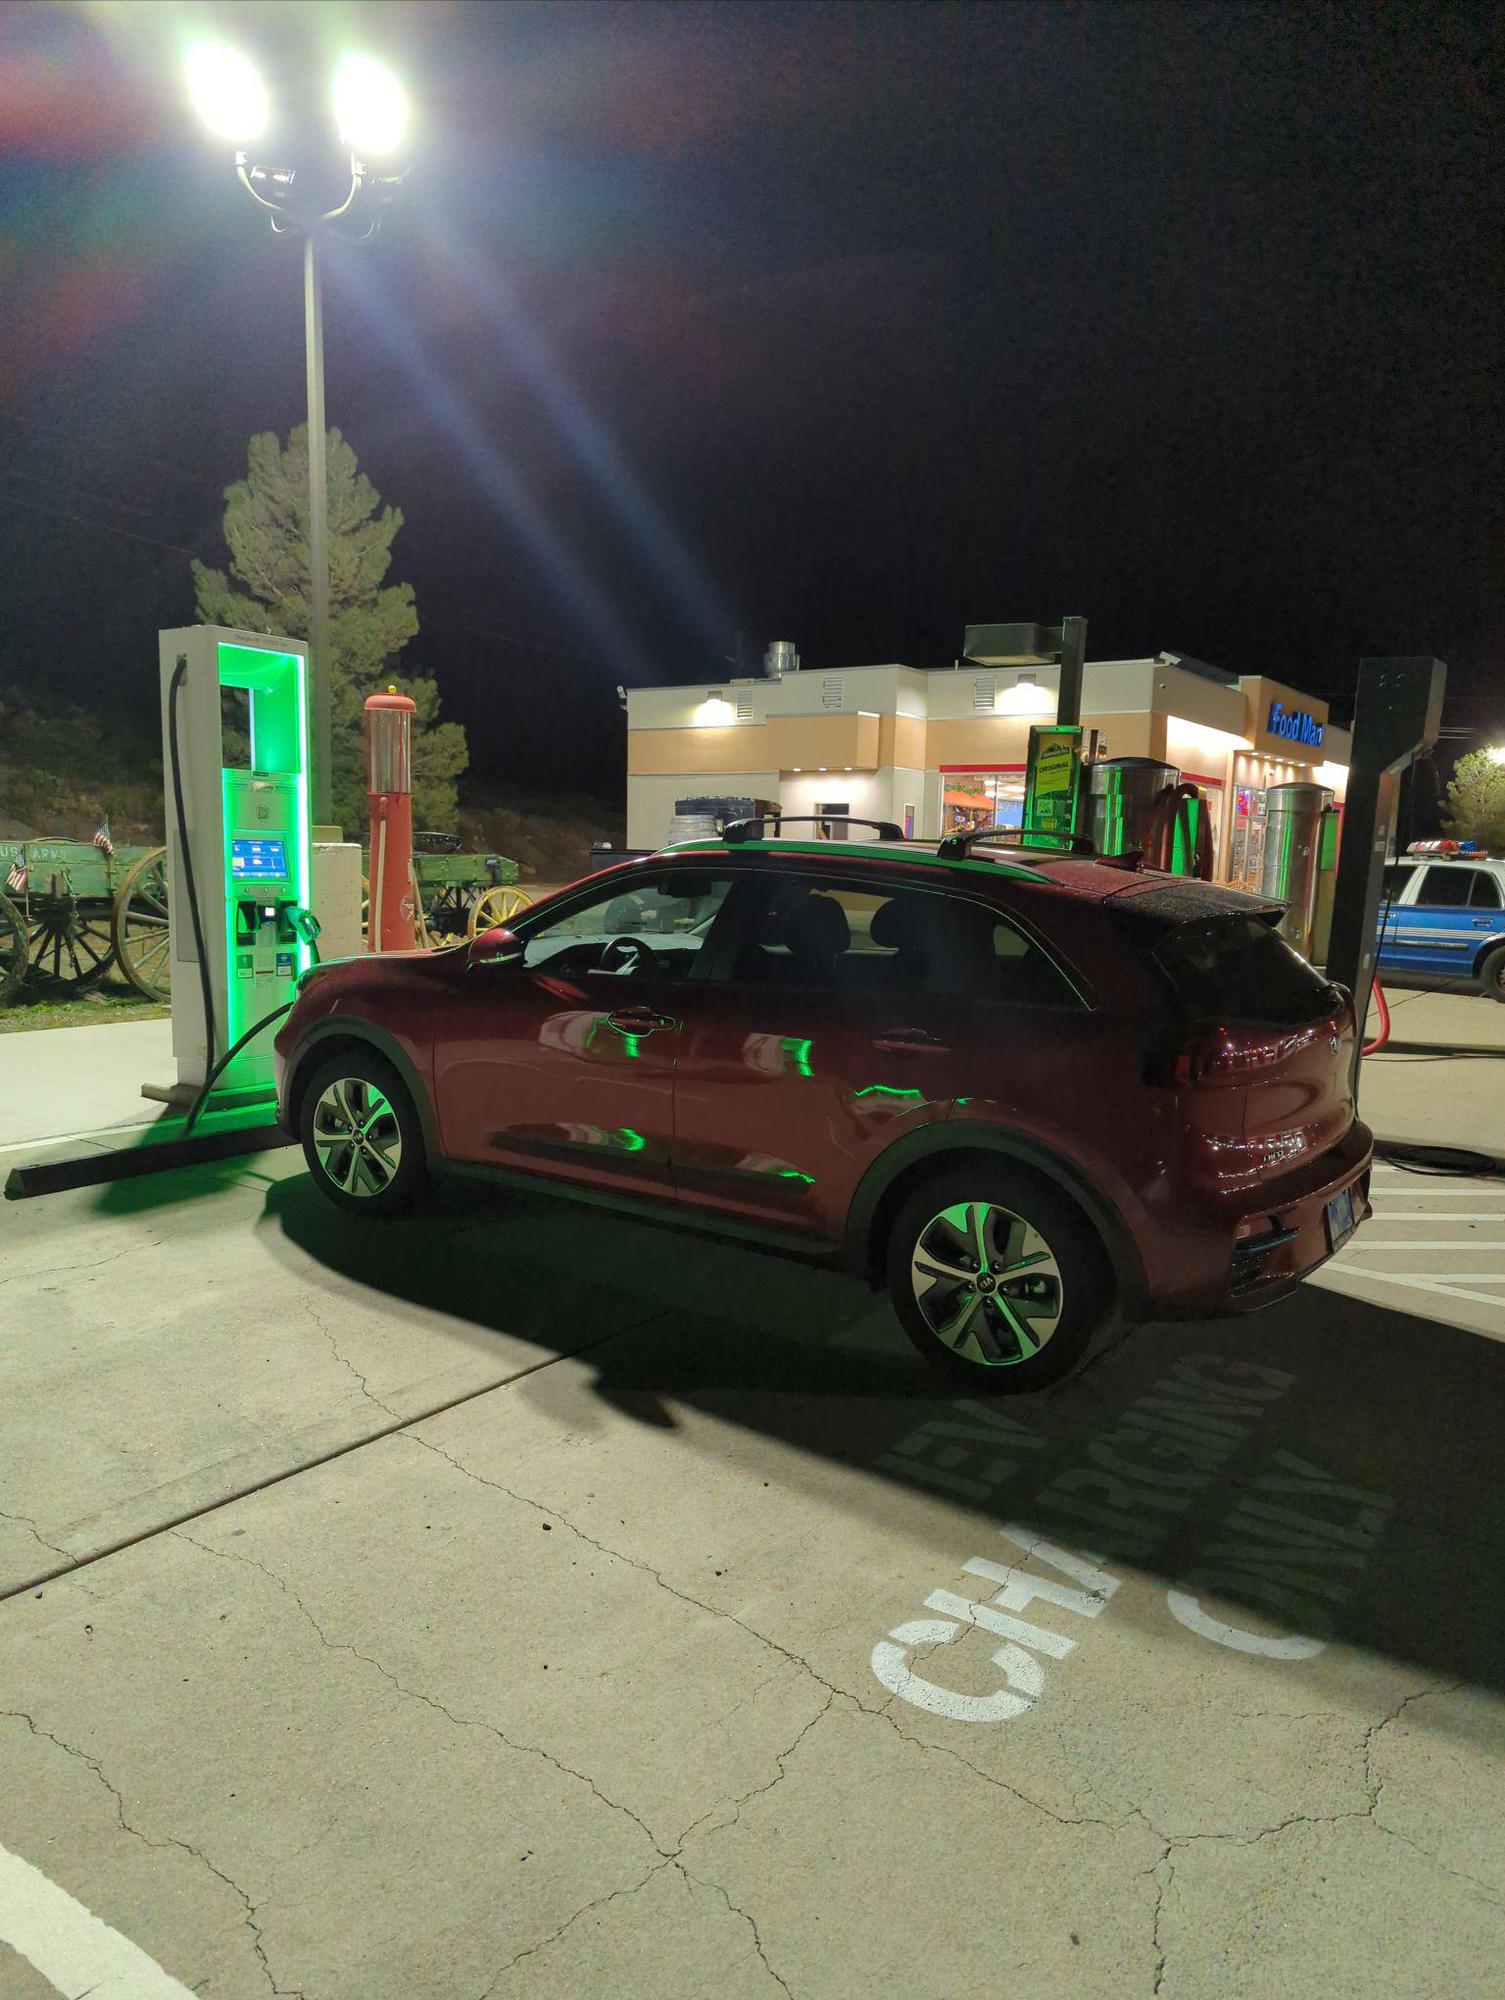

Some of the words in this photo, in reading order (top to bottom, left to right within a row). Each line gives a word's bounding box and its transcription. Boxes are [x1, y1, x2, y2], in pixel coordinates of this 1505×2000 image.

[1267, 702, 1301, 741] Food
[875, 1398, 1047, 1499] EV
[870, 1353, 1297, 1722] CHARGING
[1167, 1448, 1396, 1660] ONLY
